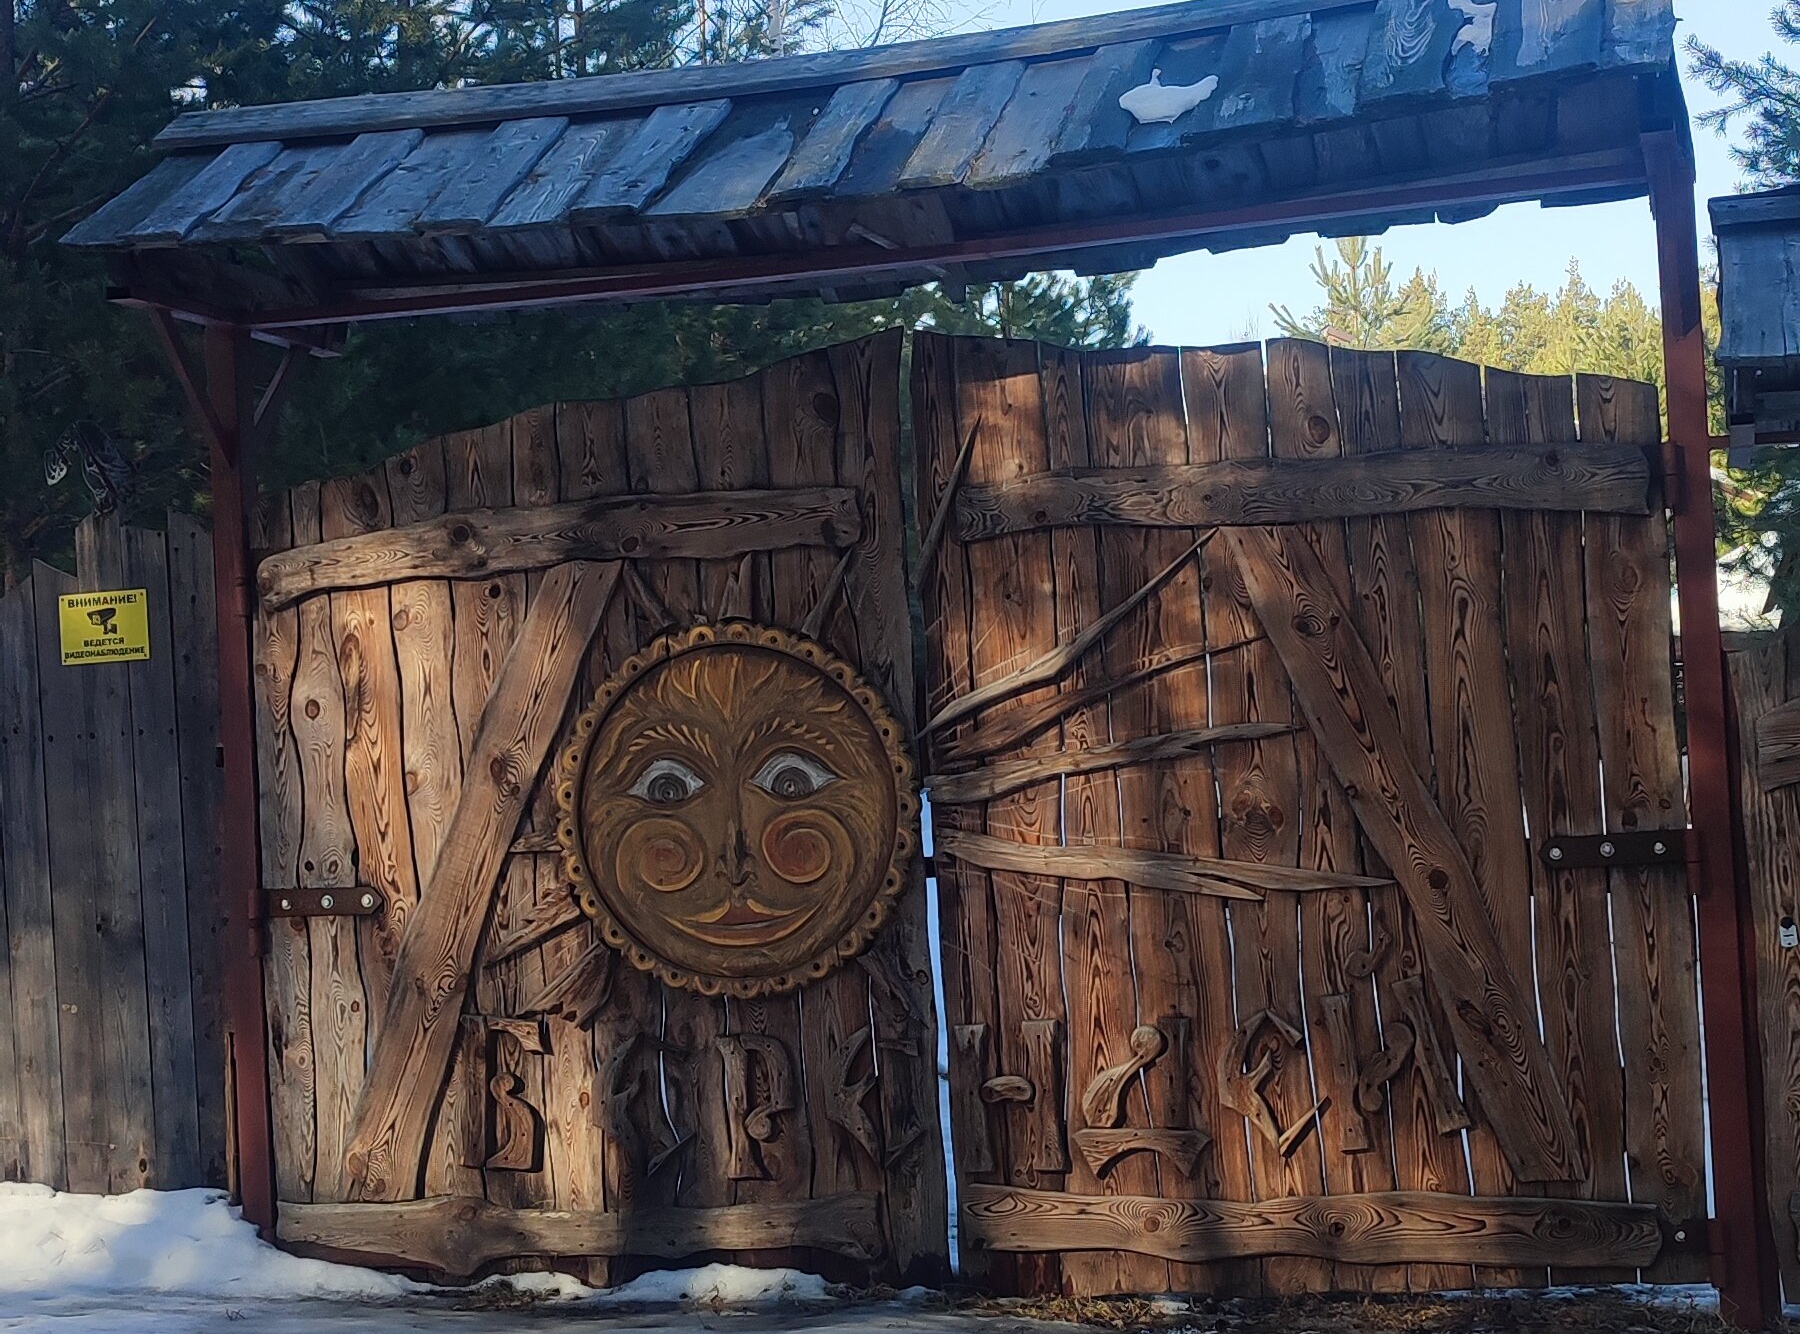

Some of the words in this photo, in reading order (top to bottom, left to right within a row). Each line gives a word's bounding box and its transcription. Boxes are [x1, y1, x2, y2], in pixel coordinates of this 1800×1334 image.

[67, 593, 137, 608] ВНИМАНИЕ!
[83, 637, 125, 647] ВЕДЕТСЯ
[64, 646, 145, 659] ВИДЕОНАБЛЮДЕНИЕ
